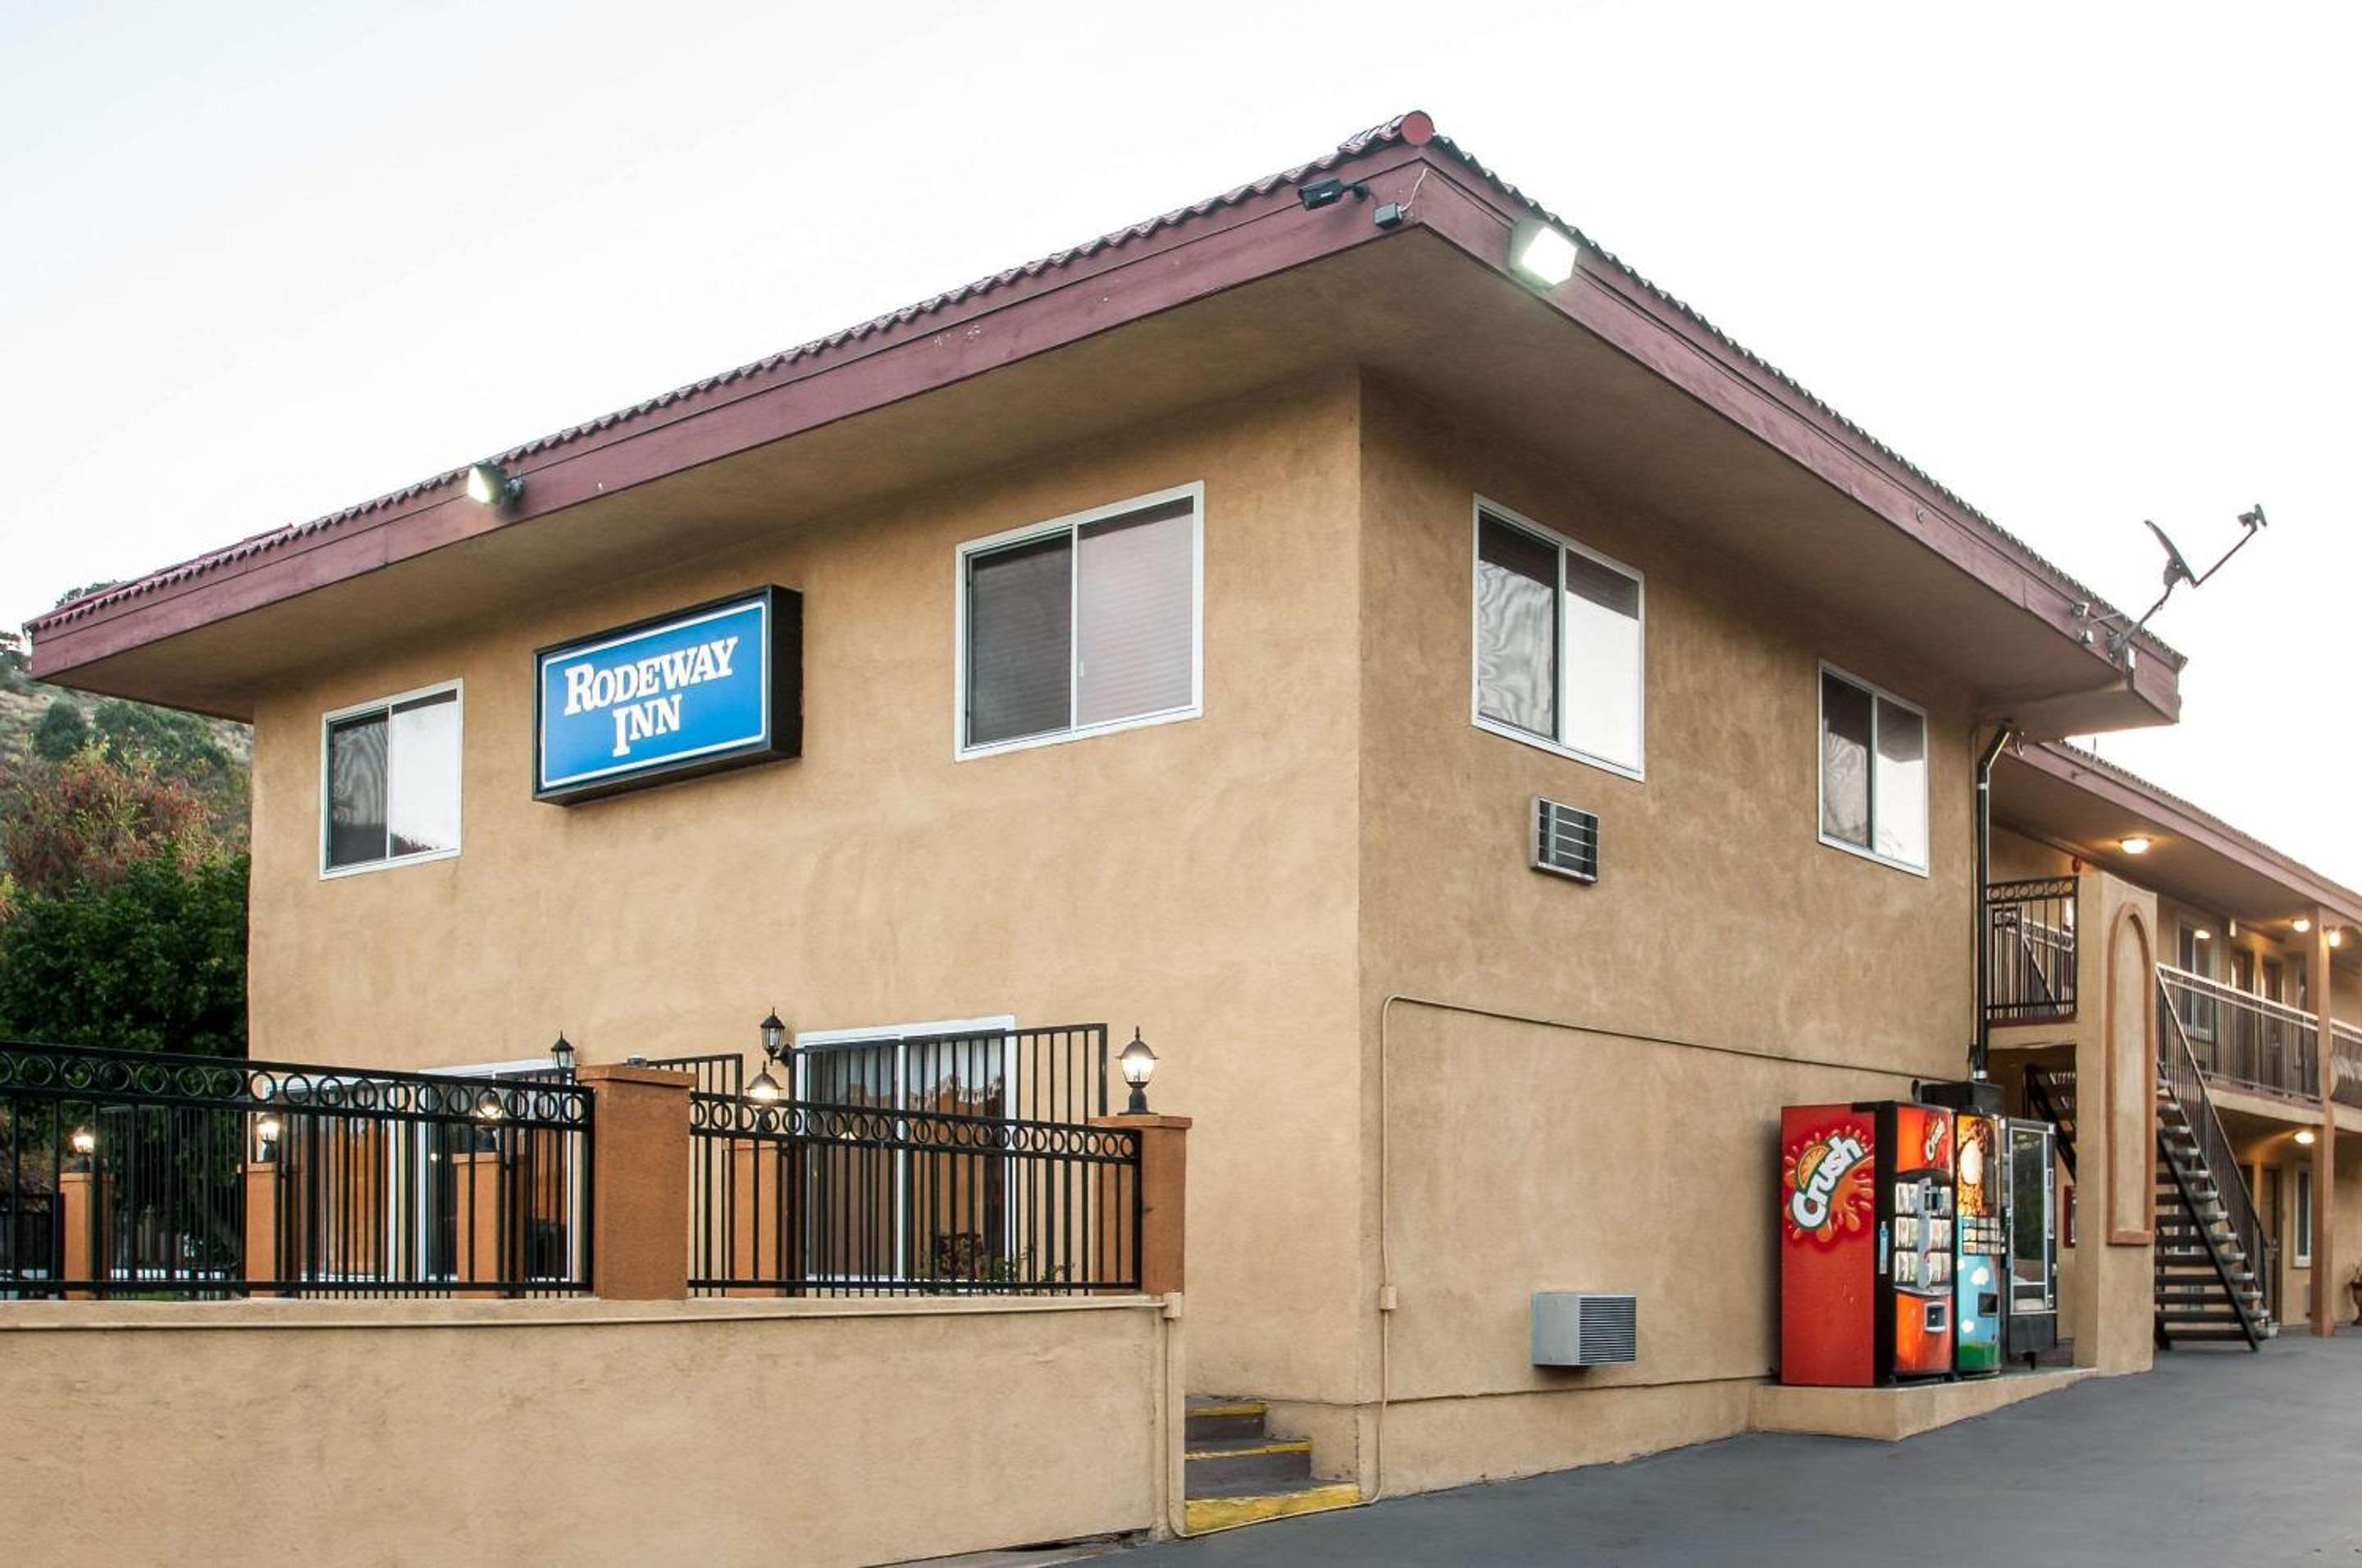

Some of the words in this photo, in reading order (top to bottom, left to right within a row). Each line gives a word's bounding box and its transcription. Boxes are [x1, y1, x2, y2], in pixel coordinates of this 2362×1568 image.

[564, 636, 738, 716] RODEWAY
[612, 695, 682, 757] INN
[1792, 1135, 1864, 1227] Crush
